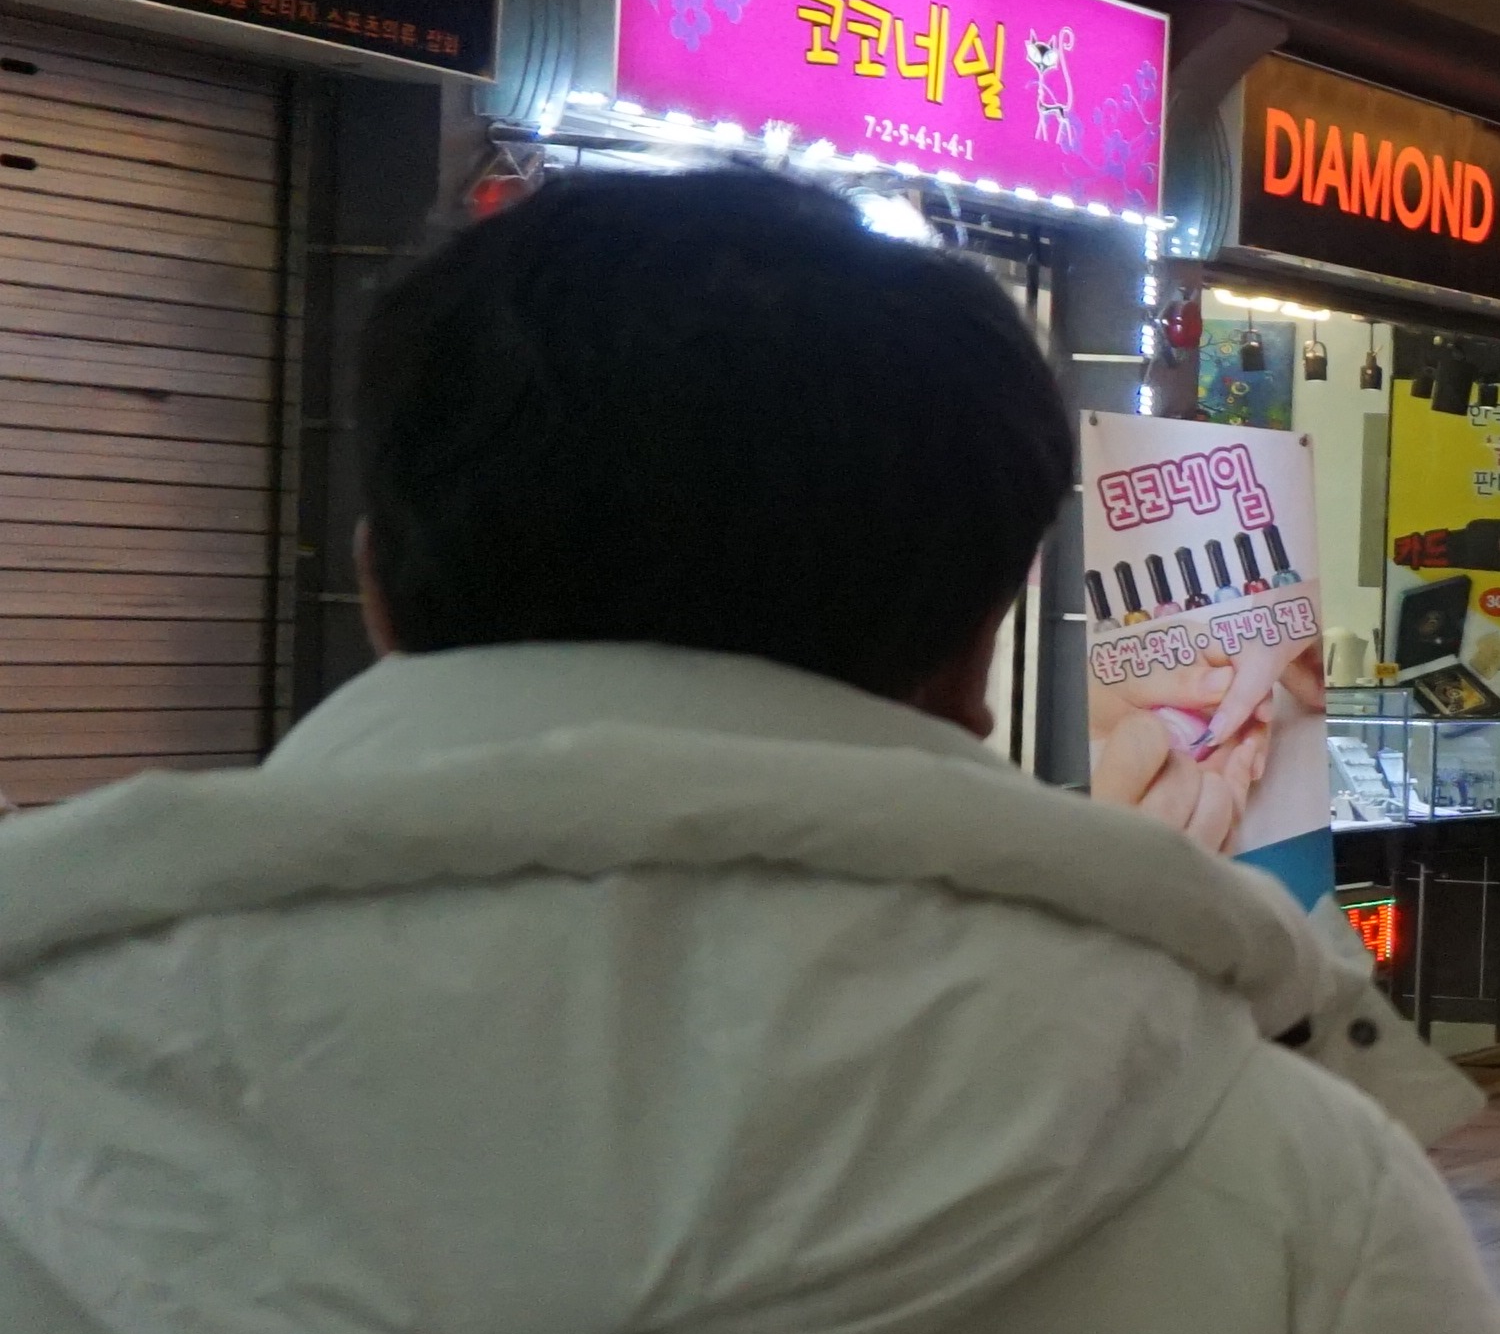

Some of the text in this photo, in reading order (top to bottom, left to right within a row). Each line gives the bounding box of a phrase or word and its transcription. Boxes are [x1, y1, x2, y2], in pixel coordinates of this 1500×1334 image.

[1263, 106, 1495, 244] DIAMOND
[1097, 443, 1274, 531] 코코네일
[1210, 605, 1282, 655] 젤네일
[1273, 596, 1319, 641] 전문
